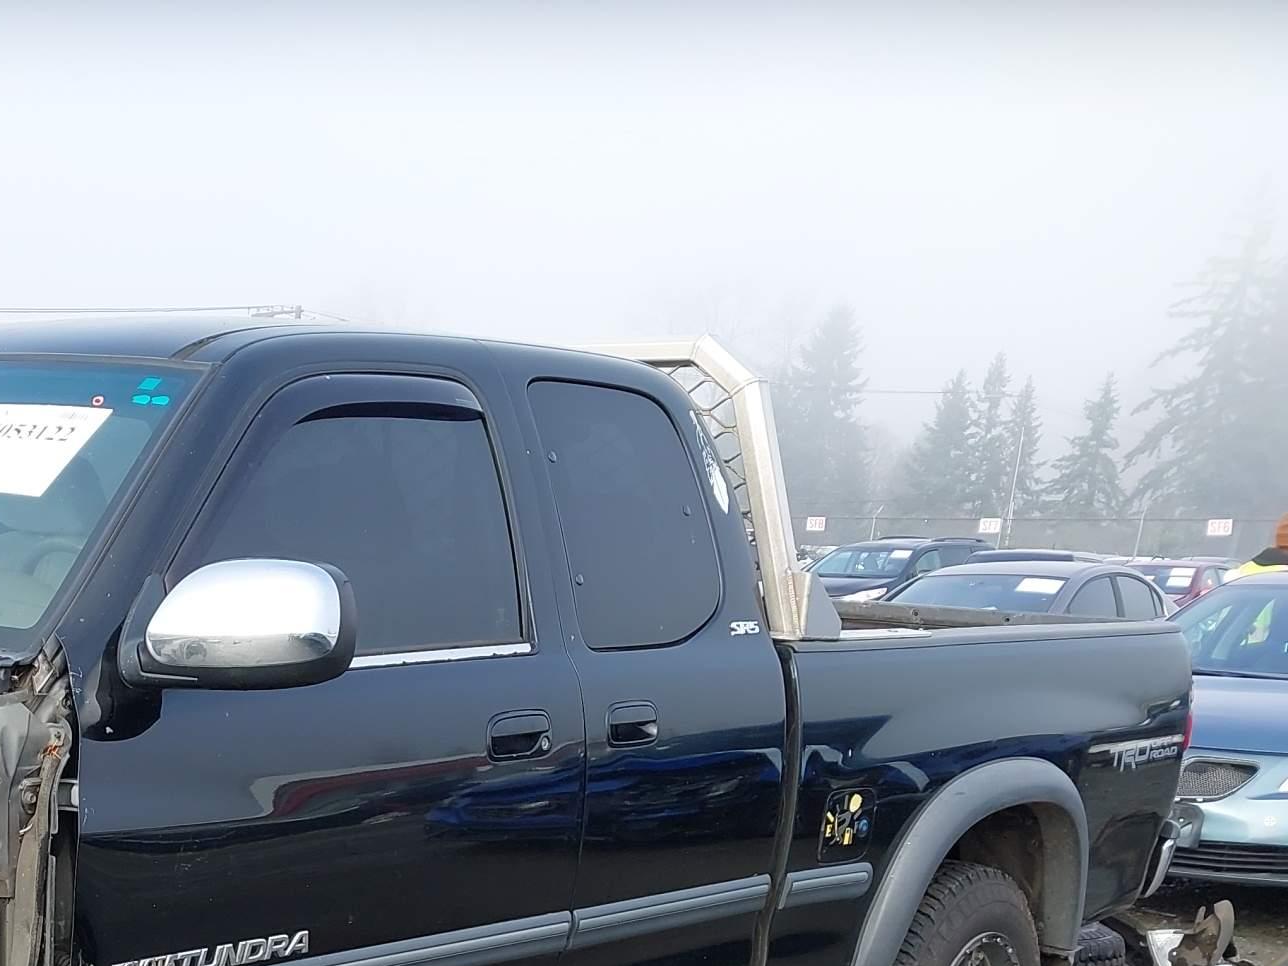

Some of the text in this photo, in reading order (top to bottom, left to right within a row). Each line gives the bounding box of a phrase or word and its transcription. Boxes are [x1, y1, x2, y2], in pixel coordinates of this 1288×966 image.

[730, 620, 760, 636] SR5
[1110, 744, 1151, 773] TRD
[1150, 745, 1178, 759] ROAD
